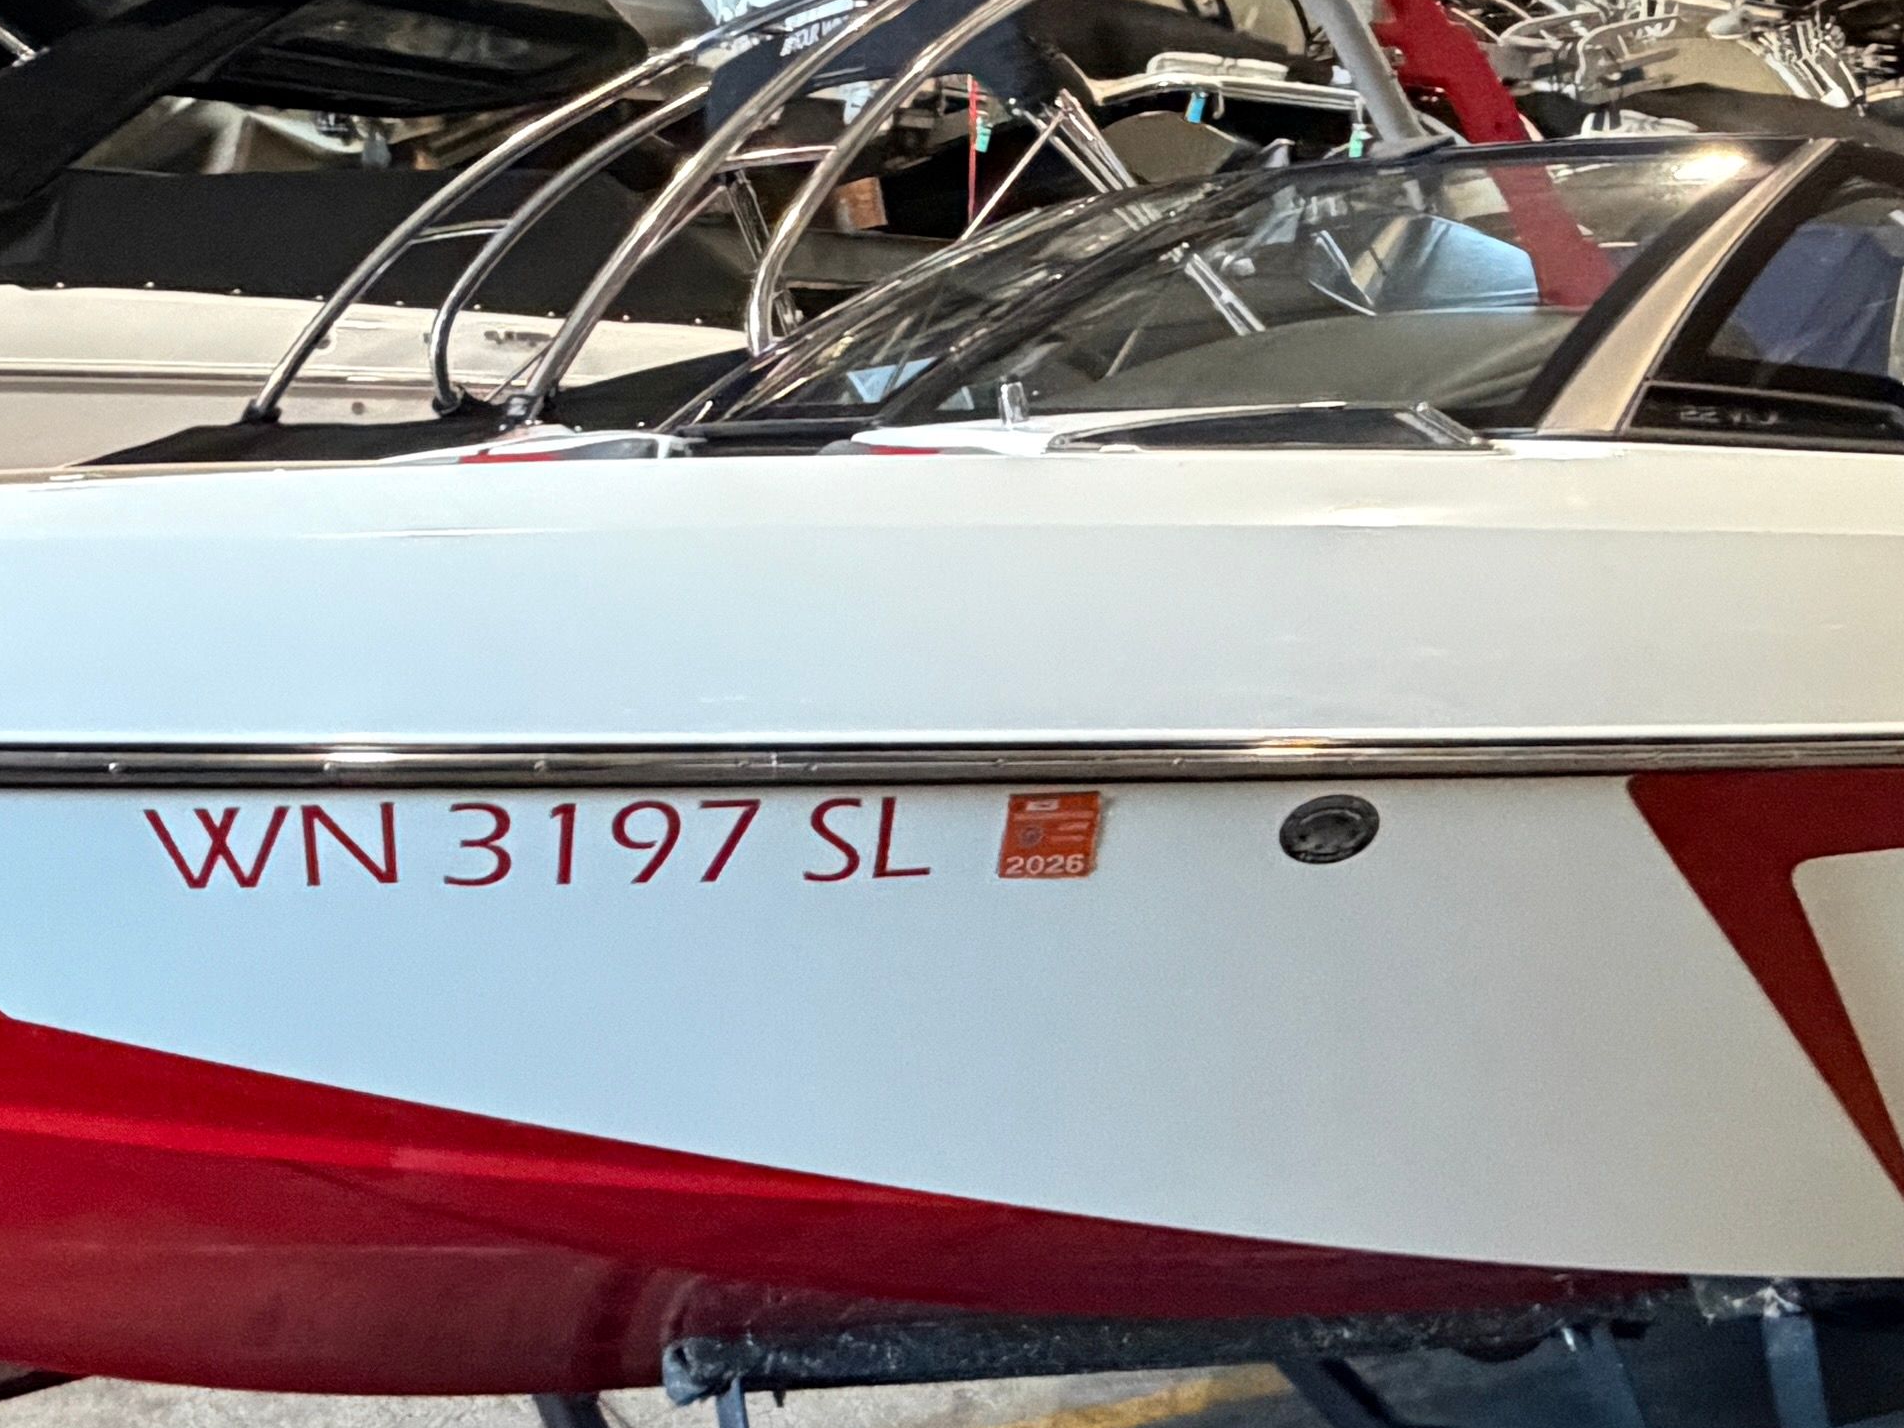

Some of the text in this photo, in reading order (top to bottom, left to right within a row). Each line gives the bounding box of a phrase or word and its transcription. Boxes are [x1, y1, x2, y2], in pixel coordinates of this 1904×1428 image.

[142, 795, 931, 890] WN 3197 SL
[1005, 853, 1085, 875] 2026
